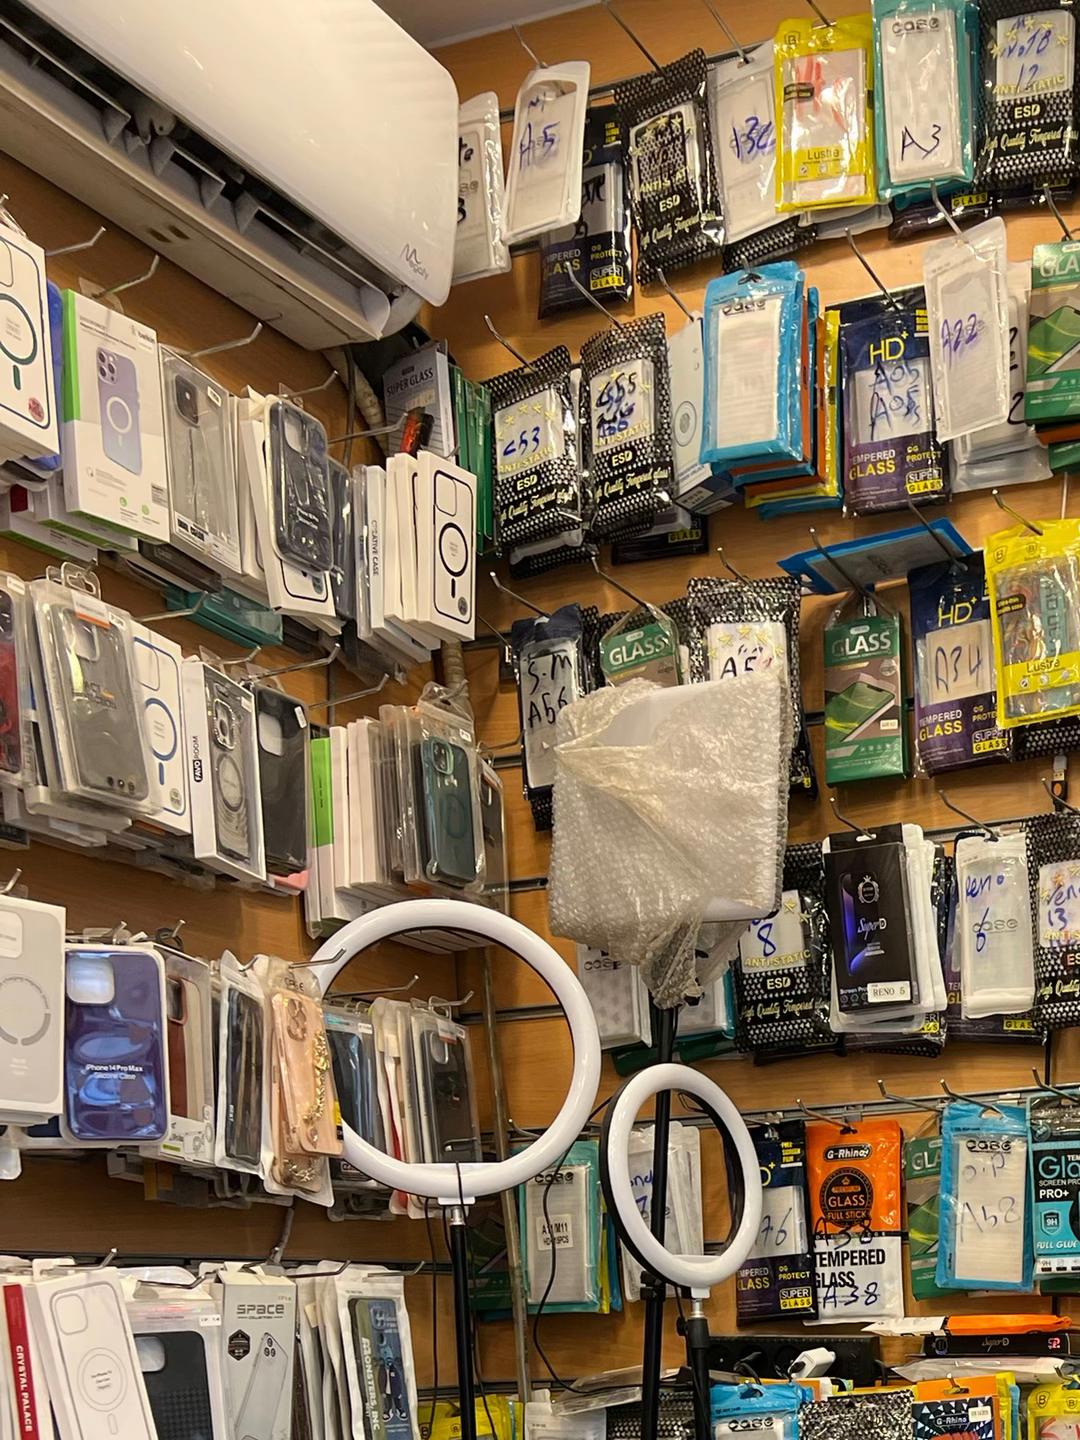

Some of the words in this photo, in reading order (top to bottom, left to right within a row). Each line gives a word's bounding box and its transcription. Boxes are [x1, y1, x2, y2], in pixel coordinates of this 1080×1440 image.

[1014, 104, 1041, 119] ESD
[659, 194, 681, 212] ESD
[409, 367, 434, 388] GLASS
[611, 449, 633, 467] ESD
[516, 473, 538, 491] ESD
[608, 634, 668, 667] GLASS
[919, 721, 963, 742] GLASS
[974, 739, 1008, 753] GLASS
[766, 977, 791, 990] ESD
[873, 987, 895, 997] RENO
[1005, 1020, 1033, 1029] GLAS
[826, 1147, 868, 1159] G-Rhino
[912, 1151, 942, 1171] GLA
[1039, 1189, 1069, 1199] PRO+
[828, 1196, 866, 1208] GLASS
[846, 1209, 867, 1219] STICK
[1046, 1217, 1058, 1226] 9H
[1037, 1241, 1054, 1249] FULL
[815, 1248, 886, 1269] TEMPERED
[779, 1271, 811, 1281] PROTECT
[814, 1271, 855, 1289] GLASS
[782, 1289, 809, 1299] SUPER
[781, 1298, 811, 1309] GLASS
[16, 1345, 26, 1391] CRYSTAL
[22, 1391, 32, 1432] PALACE
[727, 1417, 775, 1430] case
[936, 1416, 967, 1425] G-Rhino
